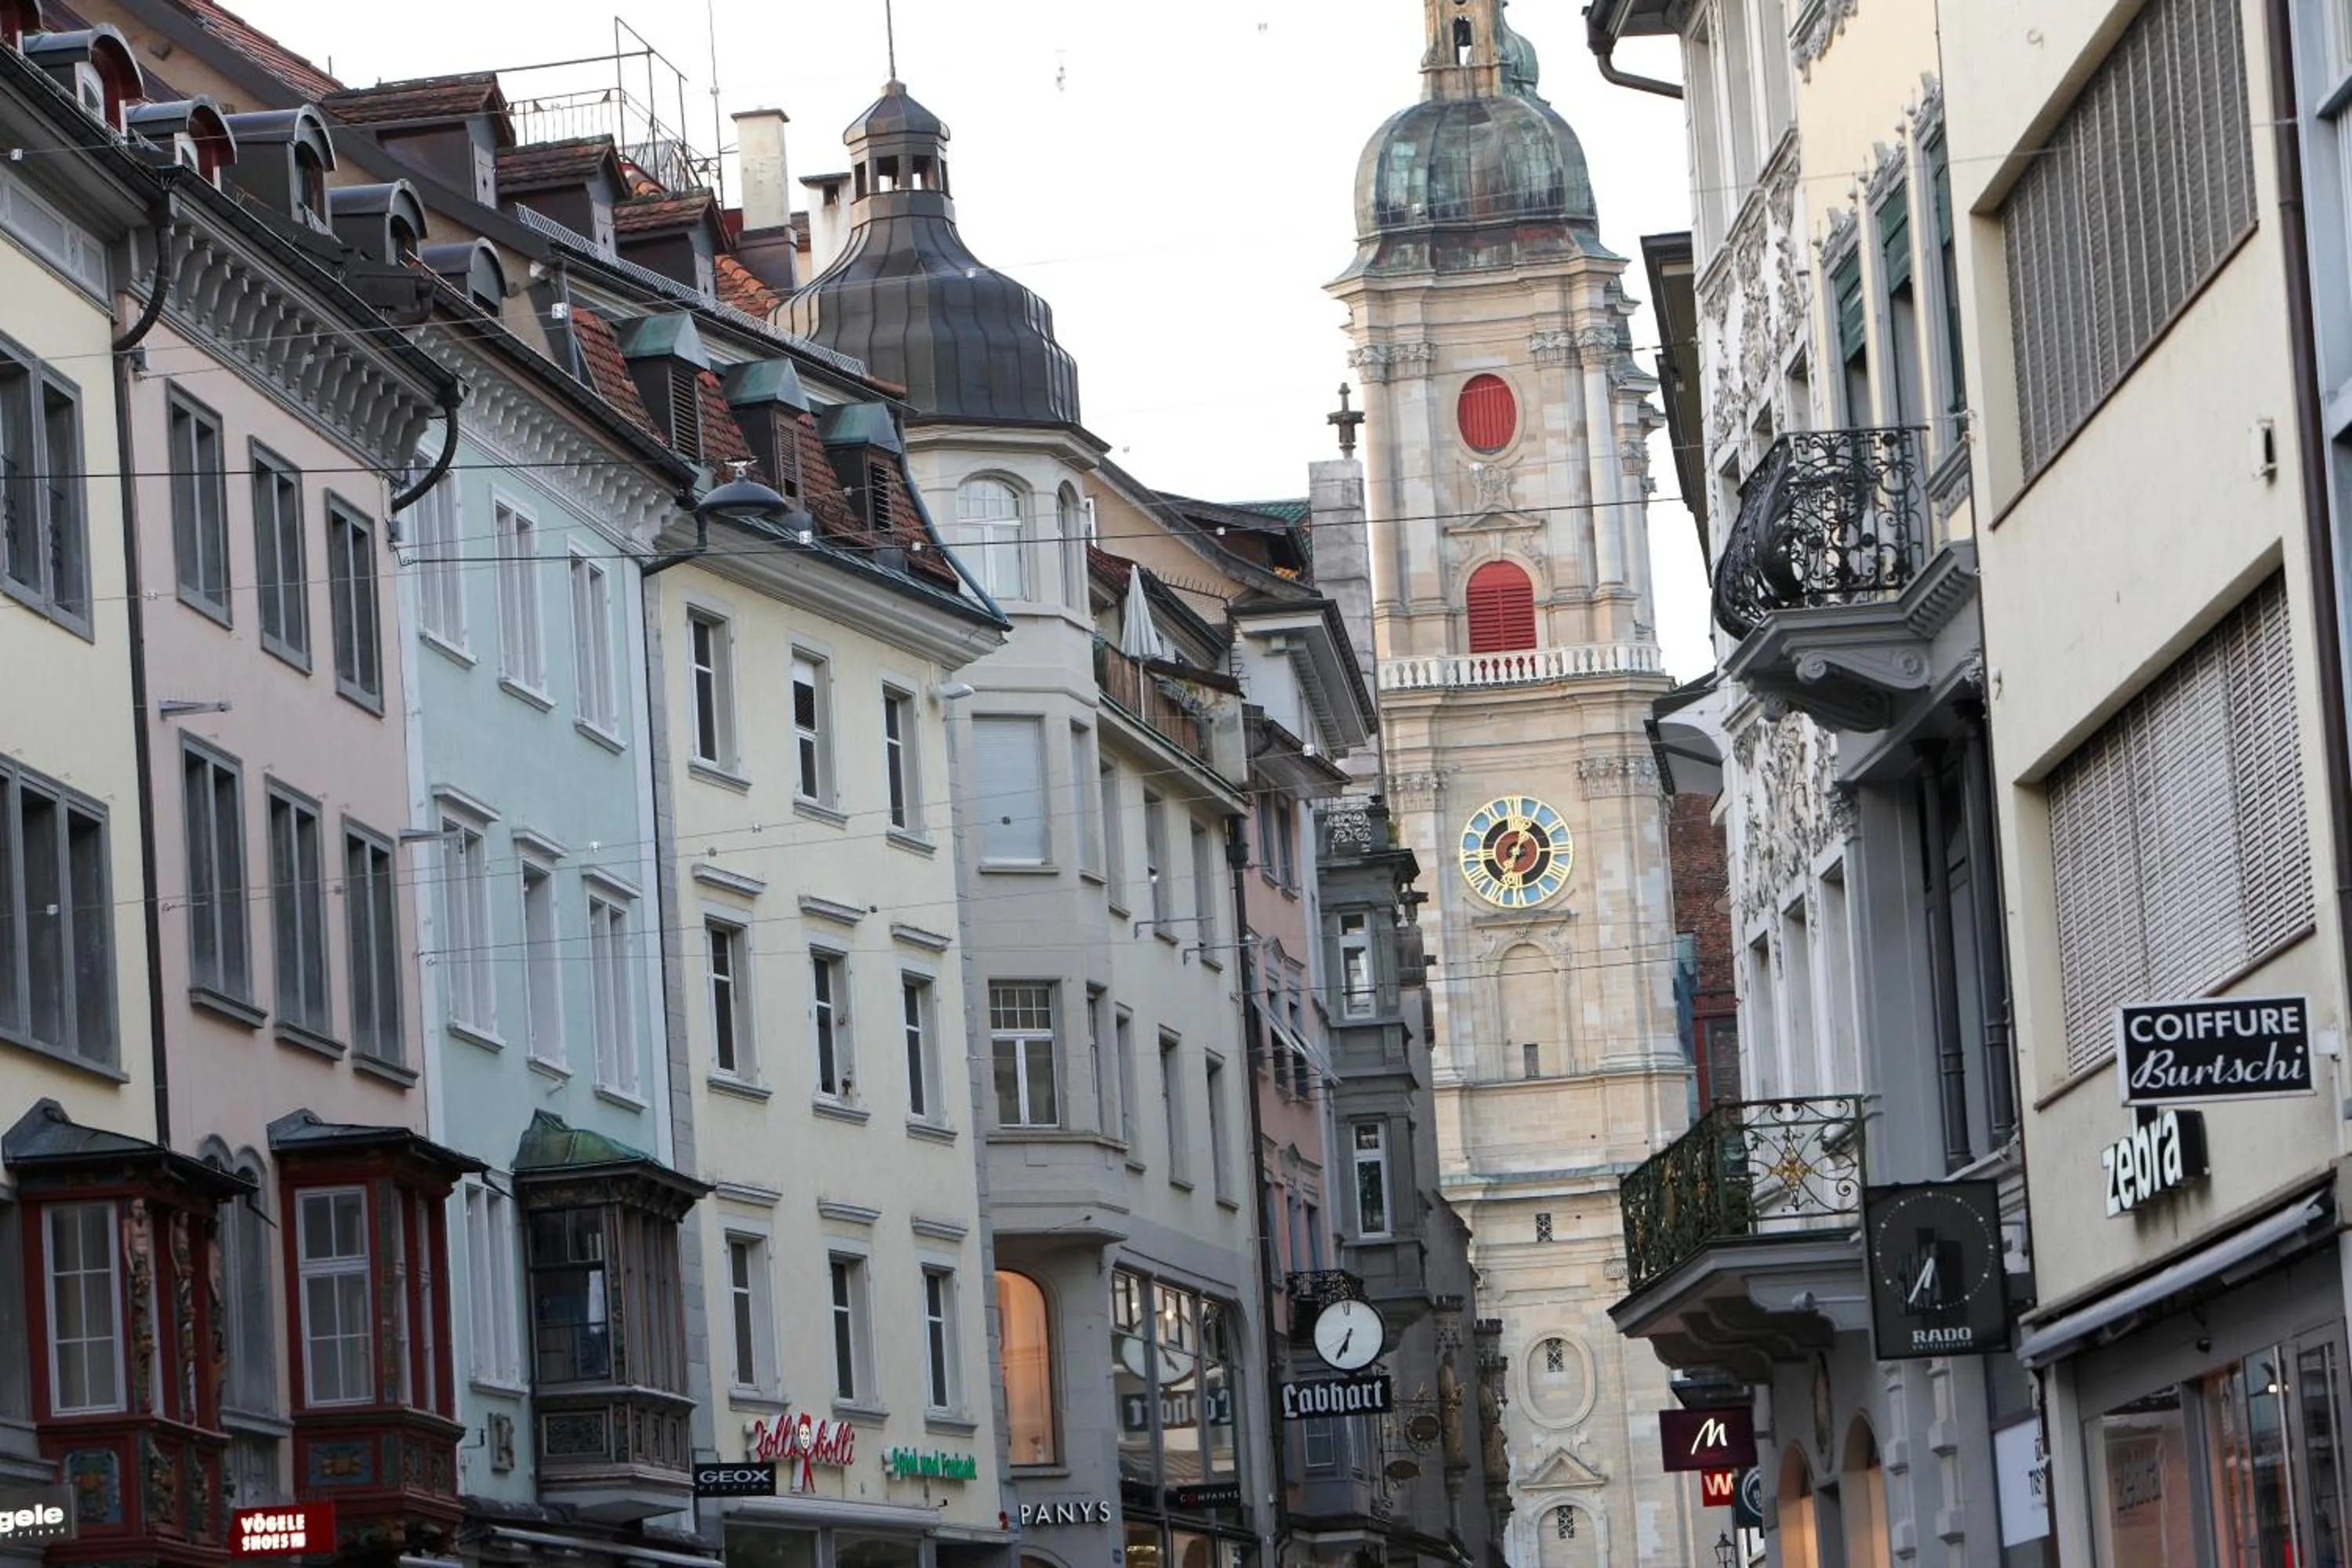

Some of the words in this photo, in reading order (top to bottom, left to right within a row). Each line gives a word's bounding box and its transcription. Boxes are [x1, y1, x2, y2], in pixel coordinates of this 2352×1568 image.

[2129, 1007, 2299, 1043] COIFFURE
[2131, 1041, 2307, 1090] Burtschi
[2101, 1106, 2183, 1219] zebra
[1911, 1326, 1973, 1343] RADO
[1283, 1380, 1384, 1418] Labhart
[699, 1469, 771, 1484] GEOX
[0, 1503, 64, 1533] gele
[241, 1512, 305, 1534] VÖGELE
[1020, 1500, 1111, 1526] PANYS
[241, 1533, 289, 1552] SHOES
